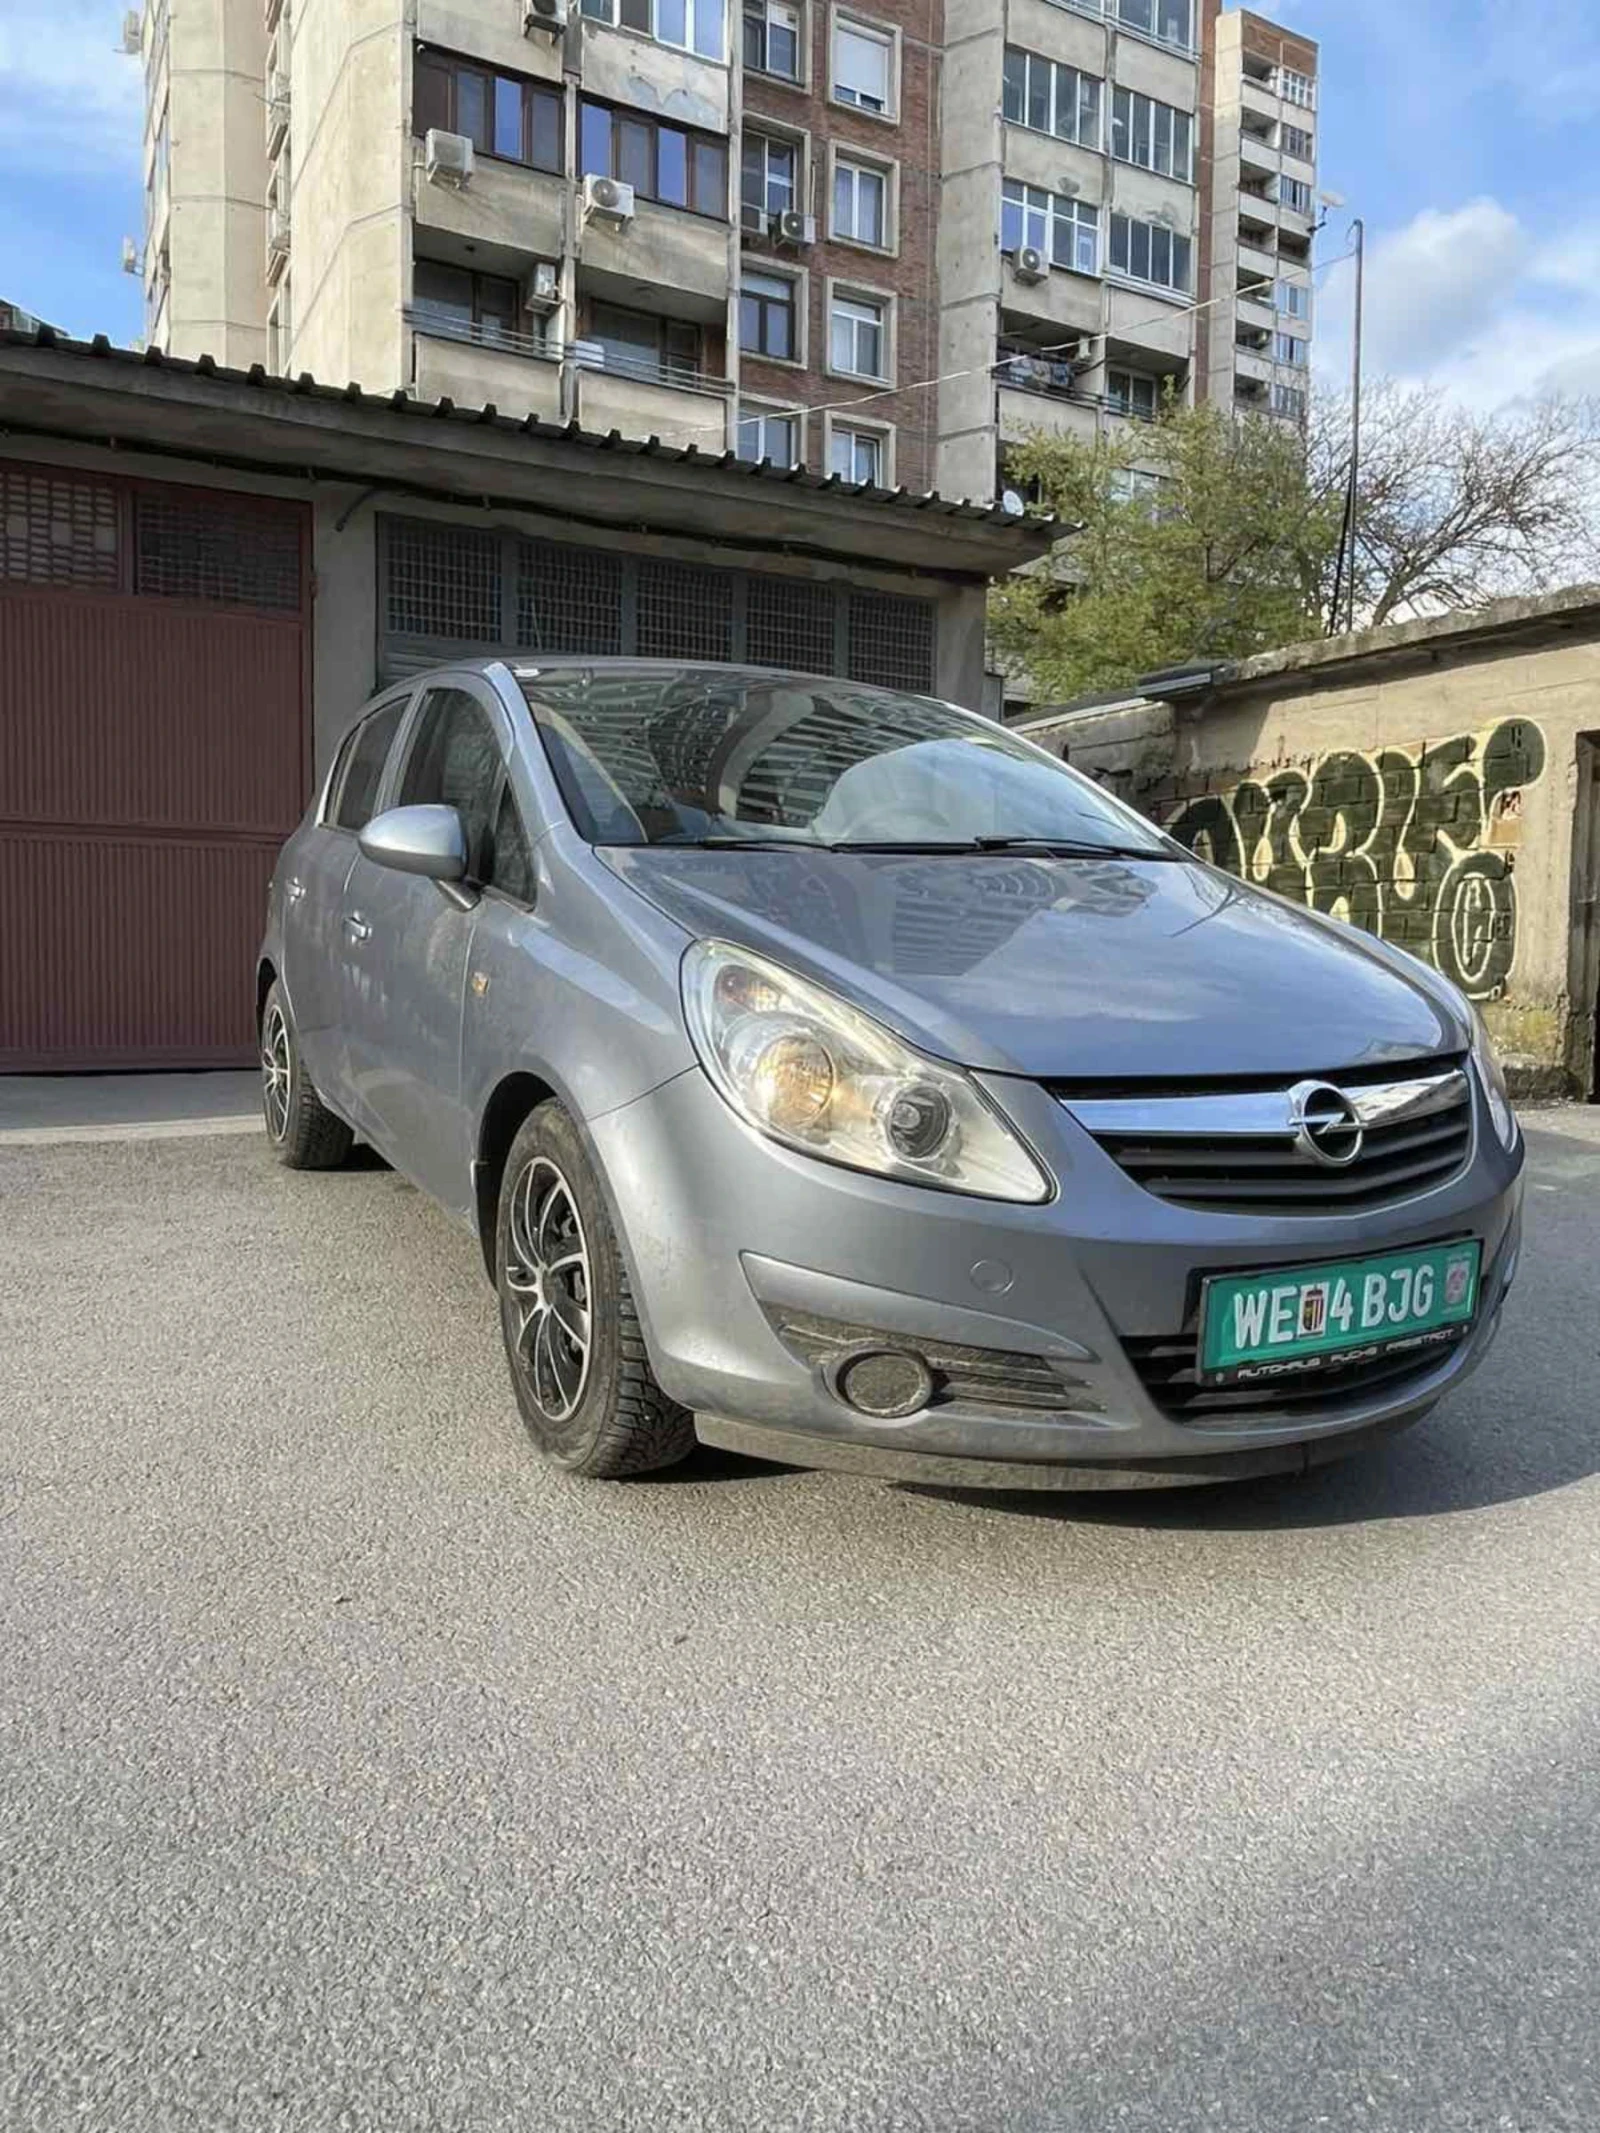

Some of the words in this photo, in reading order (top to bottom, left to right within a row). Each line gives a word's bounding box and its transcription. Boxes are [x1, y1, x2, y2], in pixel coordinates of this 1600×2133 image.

[1233, 1284, 1297, 1350] WE
[1360, 1264, 1434, 1328] BJG
[1237, 1357, 1321, 1380] AUTOHAUS
